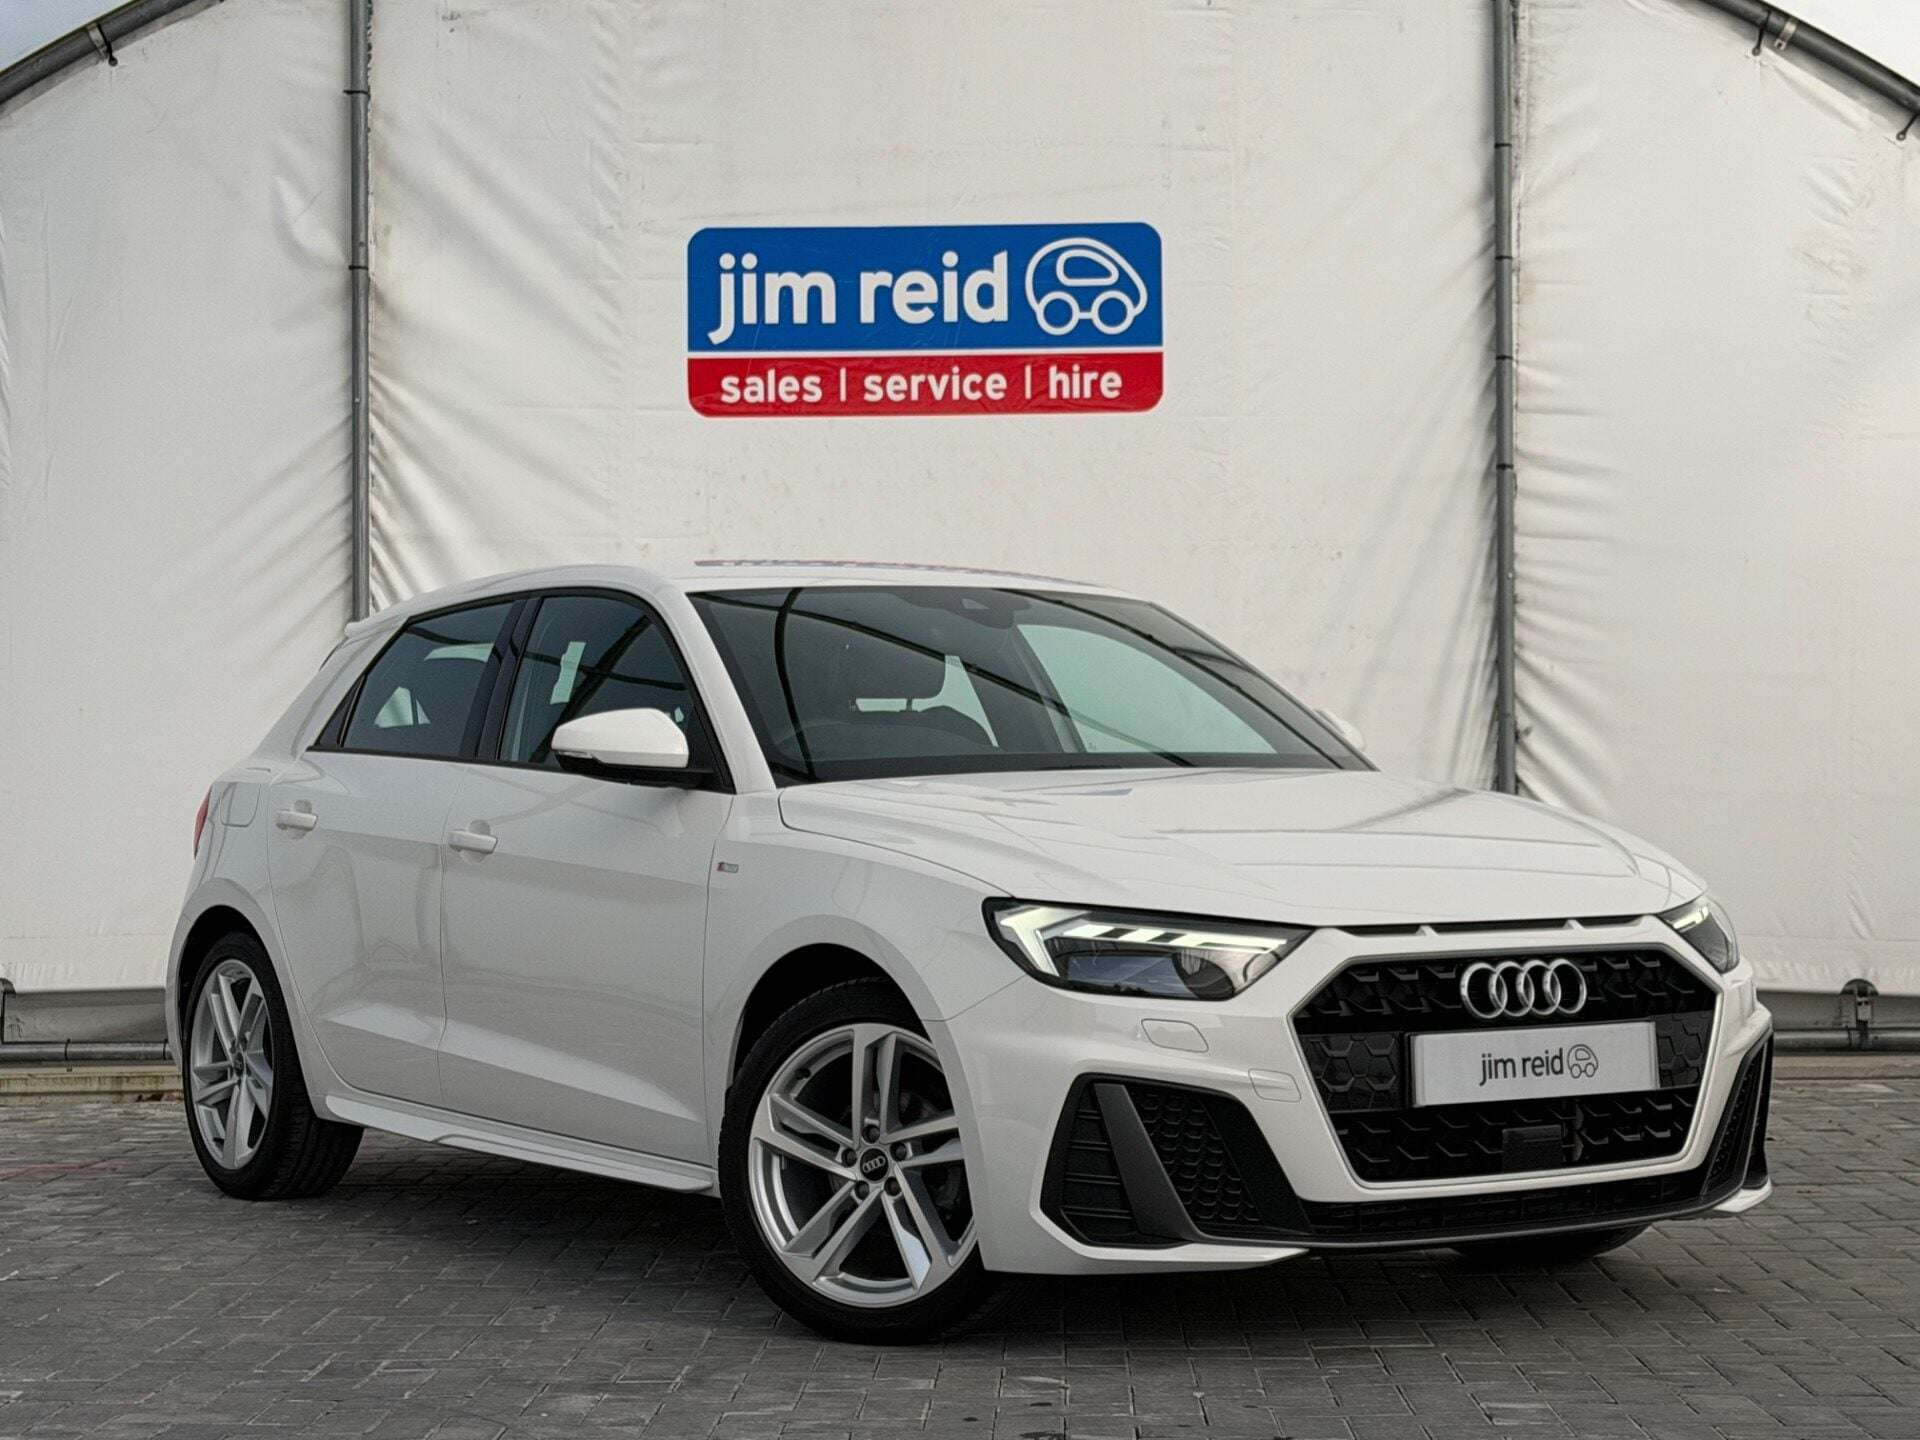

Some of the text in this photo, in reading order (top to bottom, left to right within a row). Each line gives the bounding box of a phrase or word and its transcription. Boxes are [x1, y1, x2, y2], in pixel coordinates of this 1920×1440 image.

[707, 250, 1009, 346] jim reid
[720, 364, 1123, 404] sales service hire
[1479, 1047, 1564, 1087] jim reid
